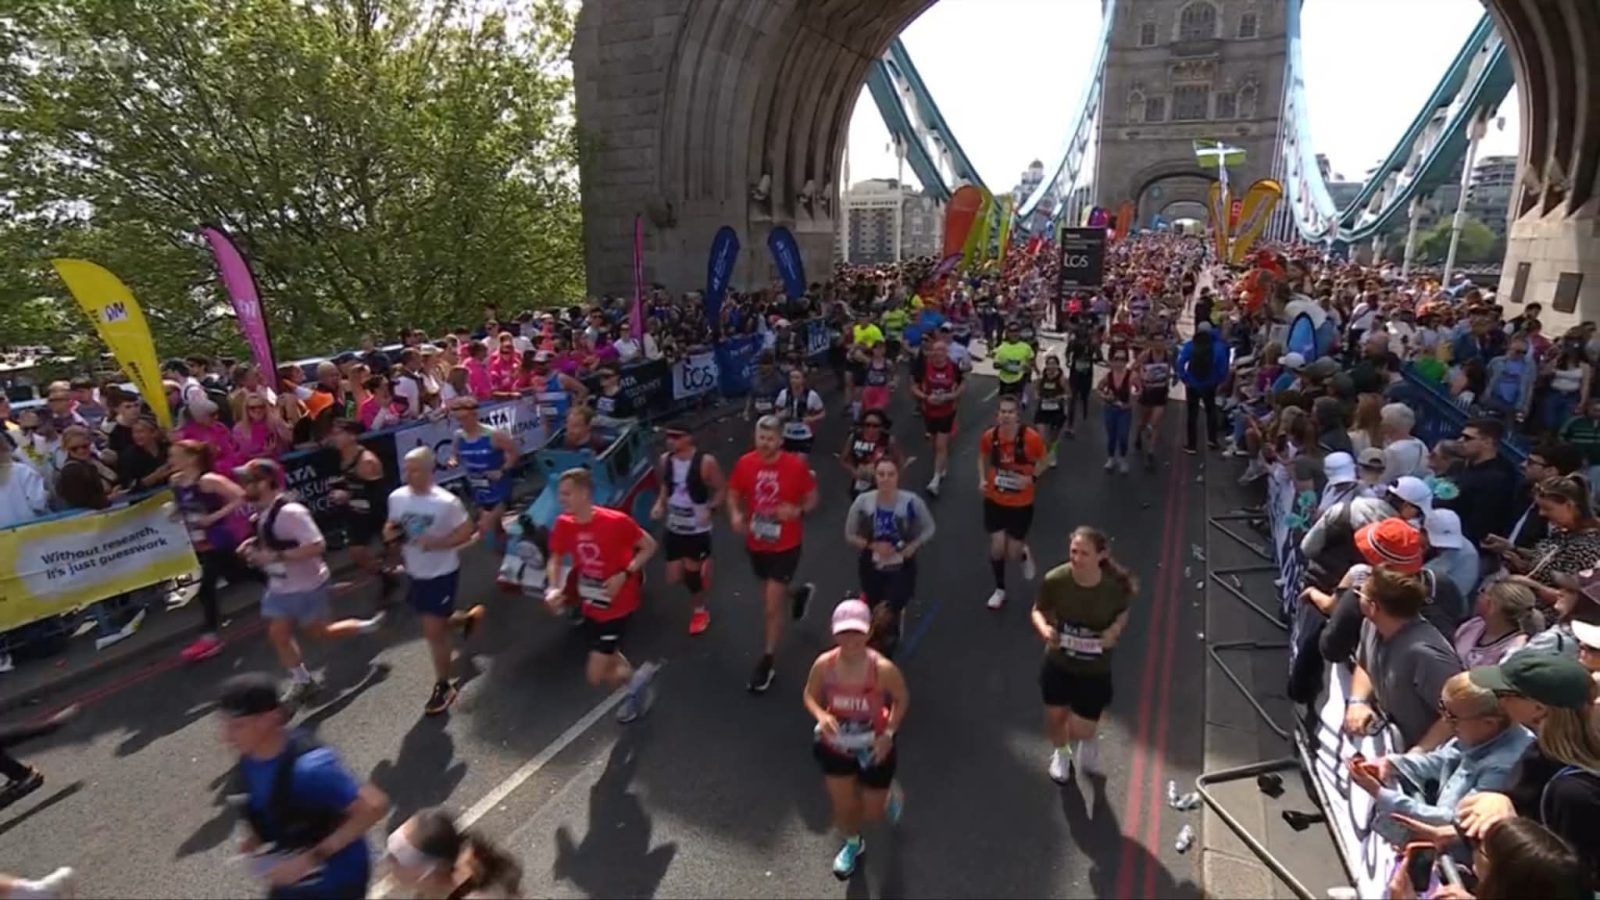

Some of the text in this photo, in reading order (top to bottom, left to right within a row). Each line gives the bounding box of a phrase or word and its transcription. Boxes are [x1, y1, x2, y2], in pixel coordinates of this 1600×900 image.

[682, 357, 714, 390] tcs
[41, 525, 159, 564] Without research,
[67, 559, 96, 575] just
[99, 537, 168, 567] guesswork
